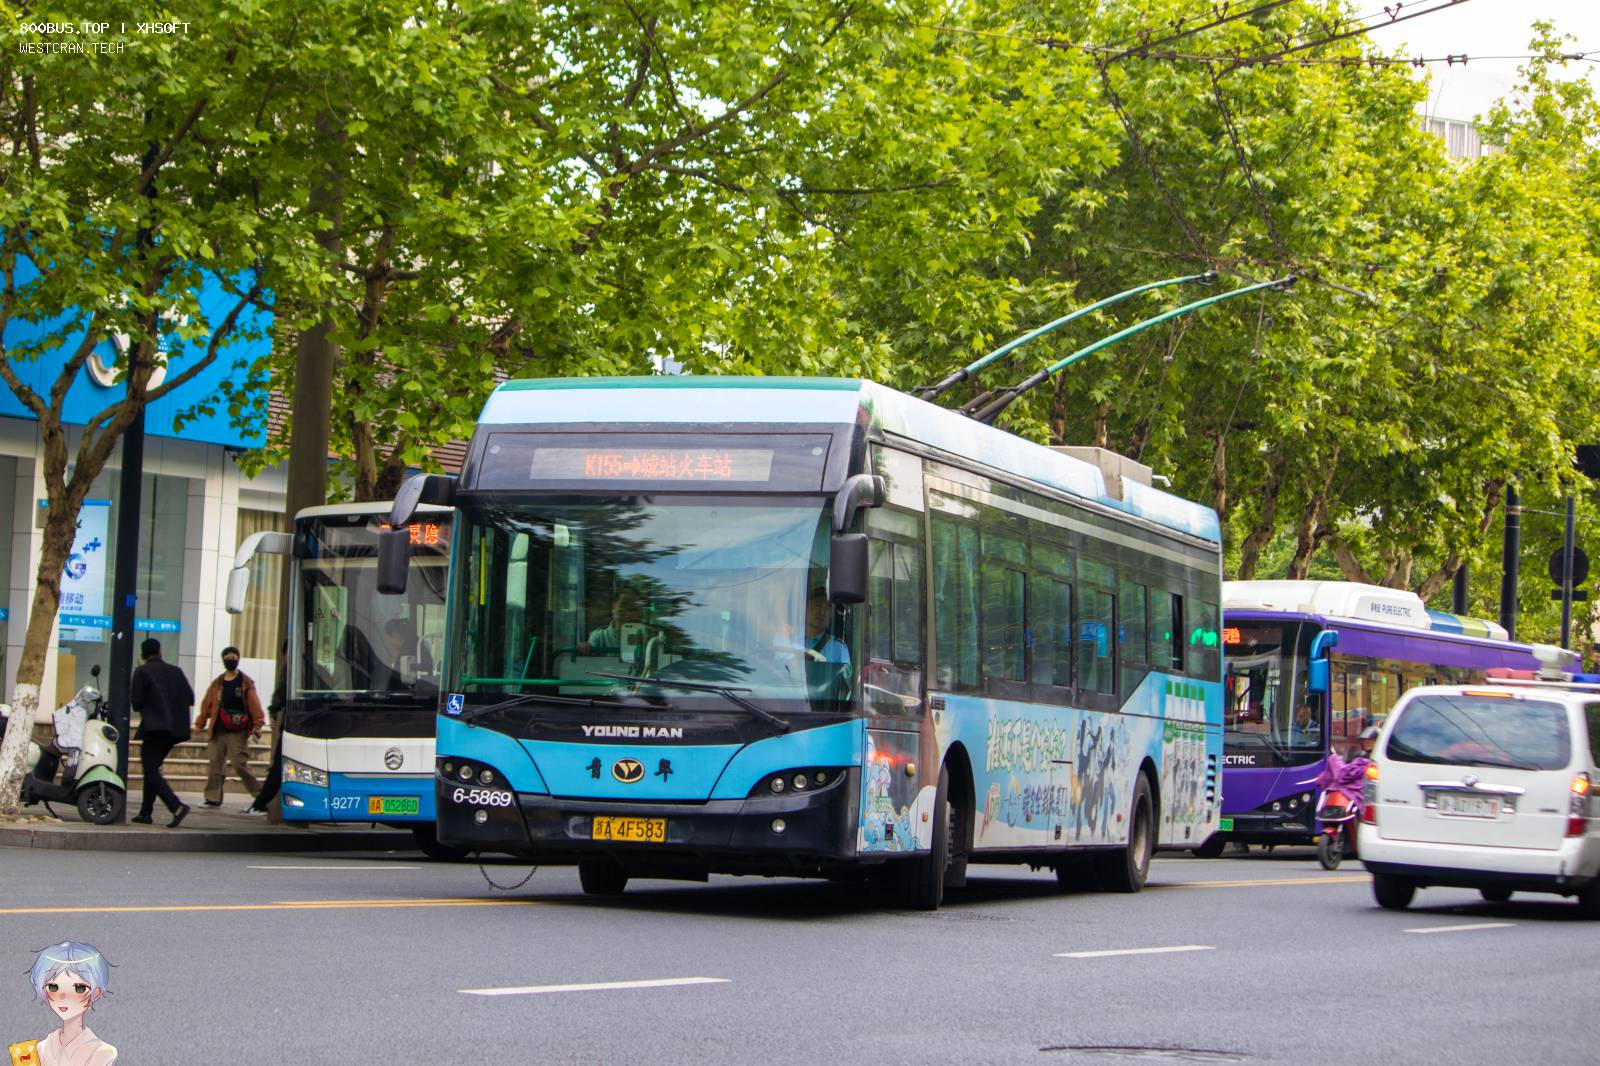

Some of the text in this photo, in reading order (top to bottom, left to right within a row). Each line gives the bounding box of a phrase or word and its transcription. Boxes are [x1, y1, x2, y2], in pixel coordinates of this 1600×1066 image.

[584, 452, 733, 480] K155 城站火车站
[581, 725, 683, 739] YOUNG MAN
[322, 796, 361, 809] 1-9277
[452, 788, 512, 808] 6-5869
